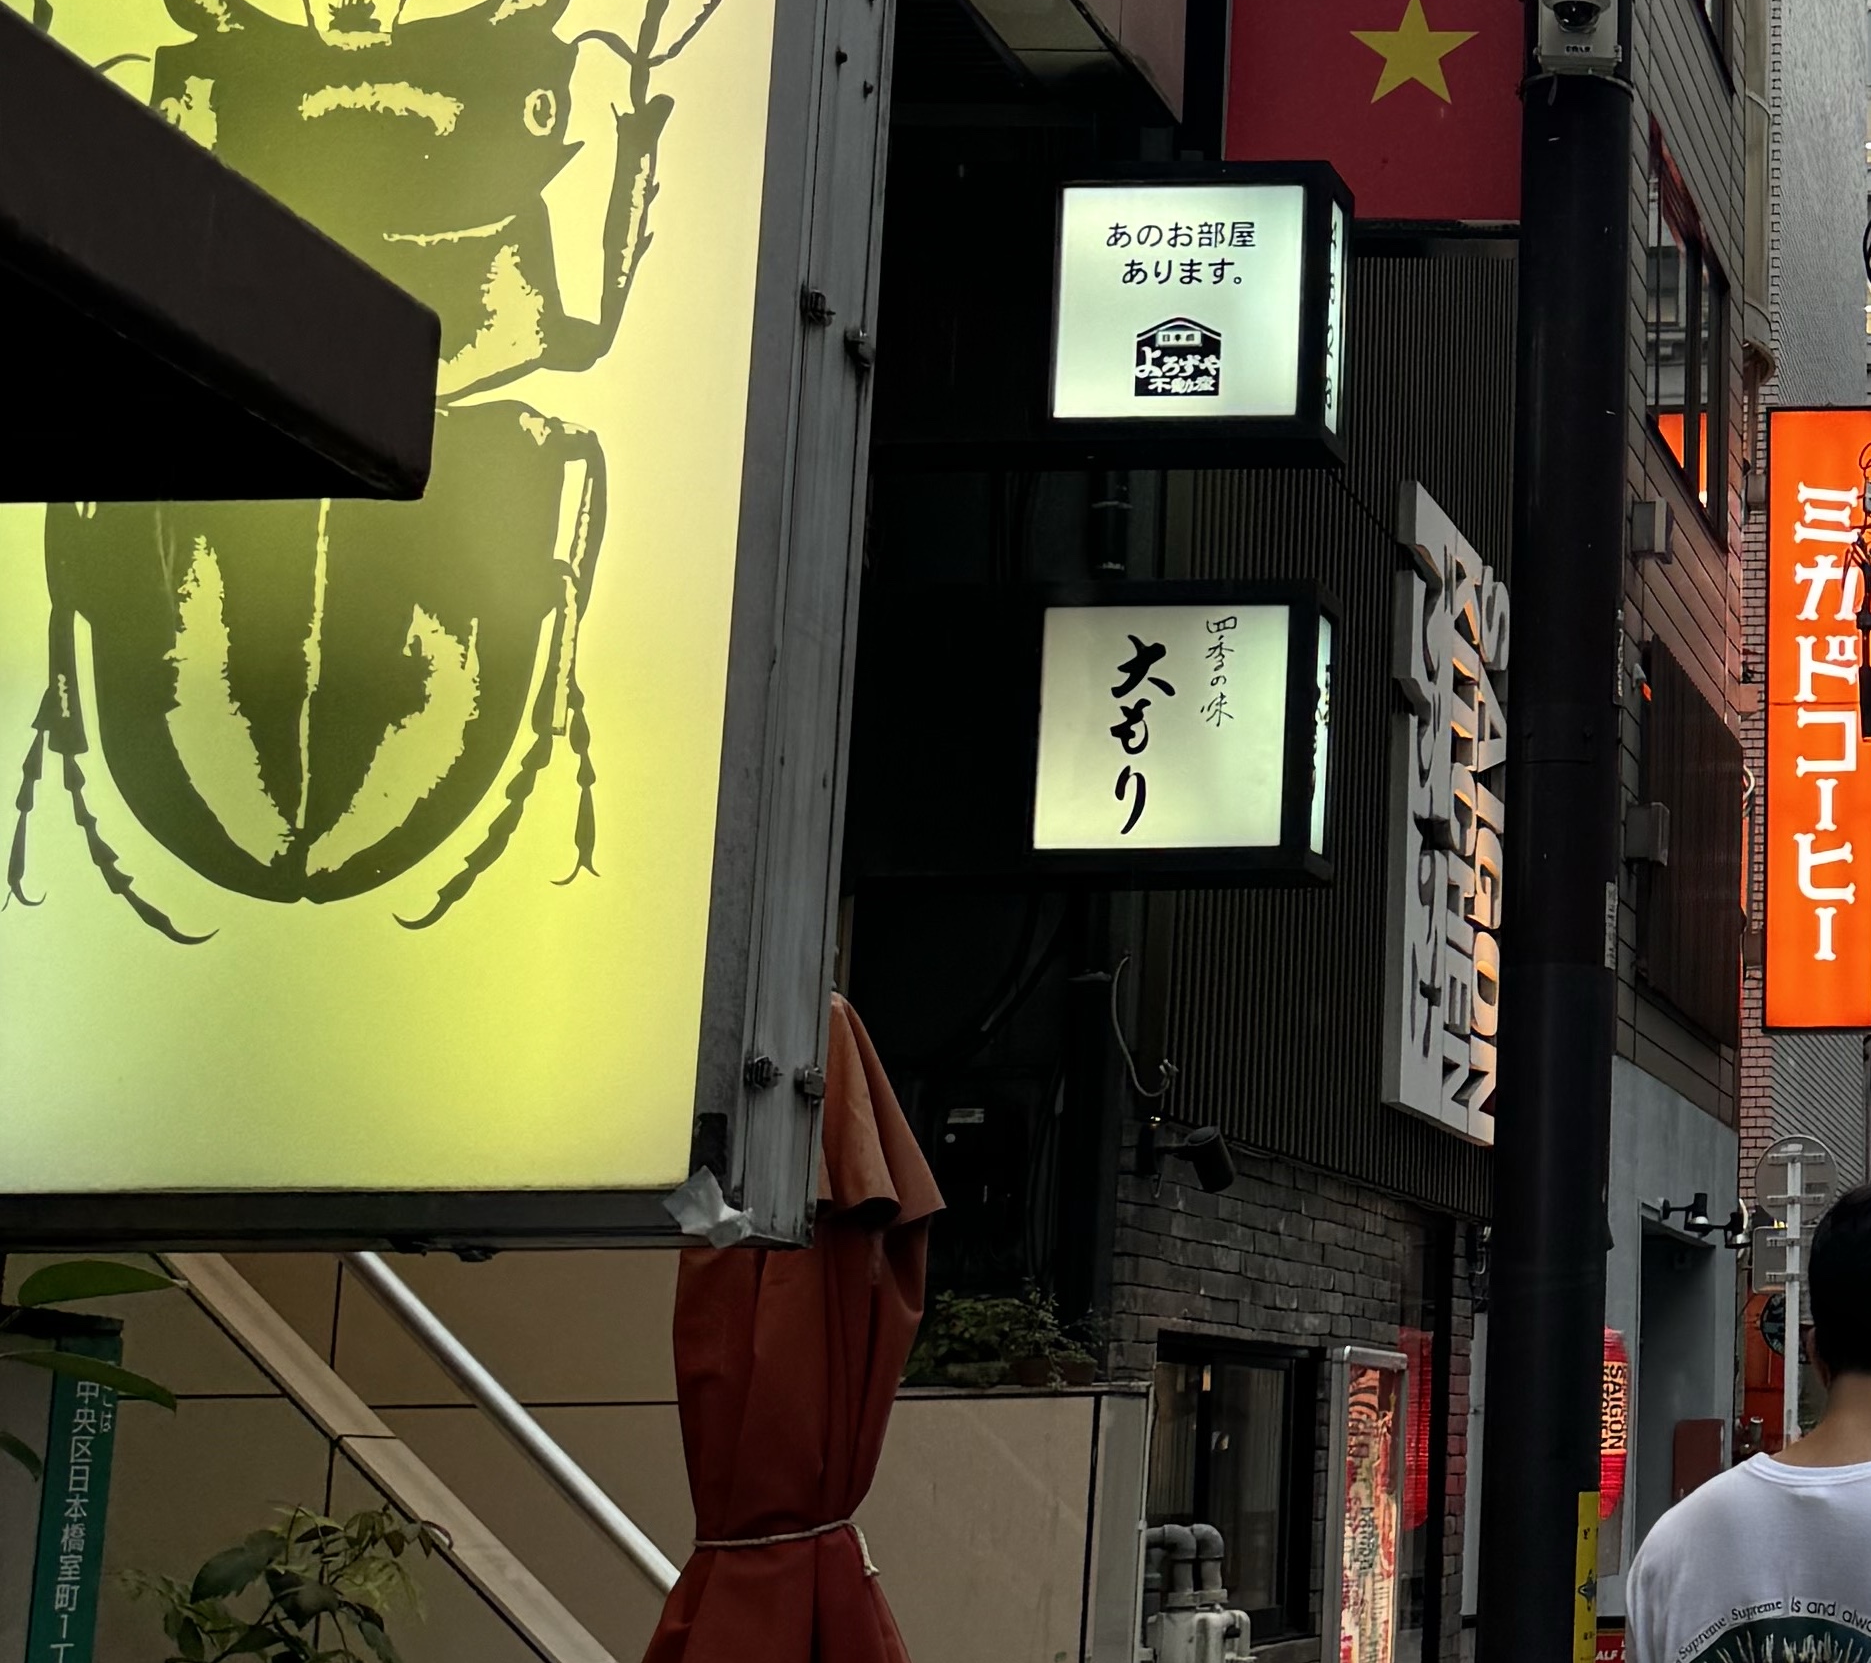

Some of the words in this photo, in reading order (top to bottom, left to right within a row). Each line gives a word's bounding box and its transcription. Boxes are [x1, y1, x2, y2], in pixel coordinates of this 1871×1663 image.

[1105, 221, 1257, 249] あのお部屋
[1121, 257, 1243, 285] あります。
[1134, 345, 1222, 379] よろずや
[1147, 376, 1217, 394] 不動産
[1109, 633, 1177, 836] 大もり
[1793, 480, 1862, 962] ミカドコーヒー
[1440, 527, 1484, 1135] KITCHEN
[1467, 564, 1511, 1147] SAIGON
[1609, 1365, 1625, 1450] SAIGON
[1807, 1601, 1837, 1617] and
